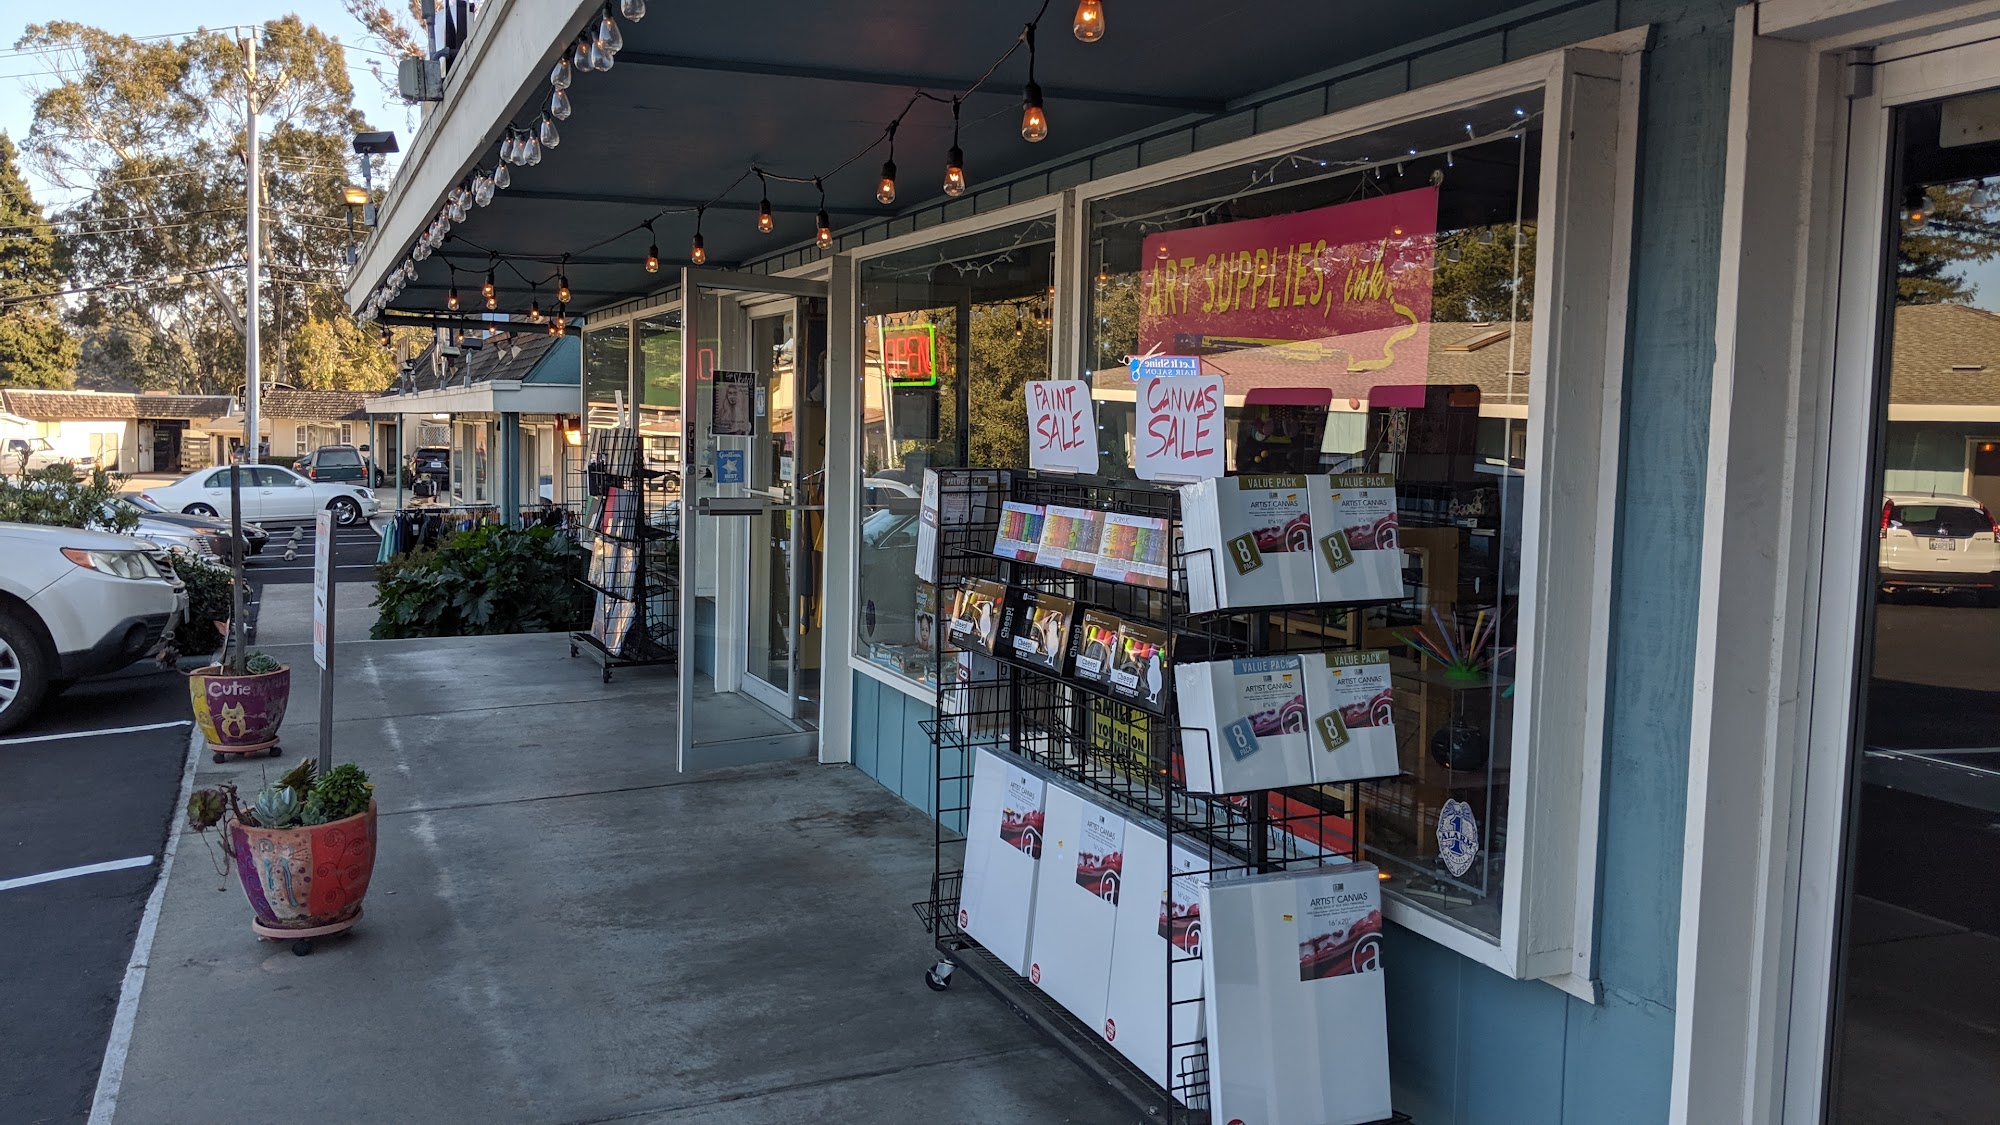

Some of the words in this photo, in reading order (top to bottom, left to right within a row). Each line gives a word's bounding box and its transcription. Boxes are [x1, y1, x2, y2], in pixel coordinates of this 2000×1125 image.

[1147, 256, 1196, 316] ART
[1202, 239, 1333, 319] SUPPLIES,
[1033, 382, 1077, 415] PAINT
[1147, 377, 1218, 414] CANVAS
[1036, 409, 1085, 453] SALE
[1146, 411, 1214, 460] SALE
[1247, 478, 1274, 489] VALUE
[1276, 477, 1297, 488] PACK
[1338, 477, 1364, 487] VALUE
[1366, 476, 1386, 487] PACK
[1250, 500, 1271, 508] ARTIST
[1341, 499, 1361, 507] ARTIST
[1236, 538, 1251, 563] 8
[1328, 536, 1343, 561] 8
[1243, 559, 1258, 572] PACK
[1334, 557, 1348, 569] PACK
[1242, 661, 1268, 673] VALUE
[1270, 659, 1290, 670] PACK
[1334, 654, 1359, 666] VALUE
[1361, 653, 1381, 664] PACK
[1245, 684, 1266, 693] ARTIST
[1267, 681, 1293, 691] CANVAS
[1337, 677, 1357, 686] ARTIST
[1358, 675, 1382, 684] CANVAS
[208, 681, 251, 698] Cutie
[1324, 716, 1339, 740] 8
[1232, 724, 1247, 748] 8
[1331, 737, 1344, 748] PACK
[1131, 735, 1144, 752] ON
[1239, 745, 1253, 757] PACK
[1100, 827, 1116, 840] CANVAS
[1441, 831, 1474, 849] ALARM
[1310, 896, 1336, 907] ARTIST
[1337, 892, 1368, 904] CANVAS
